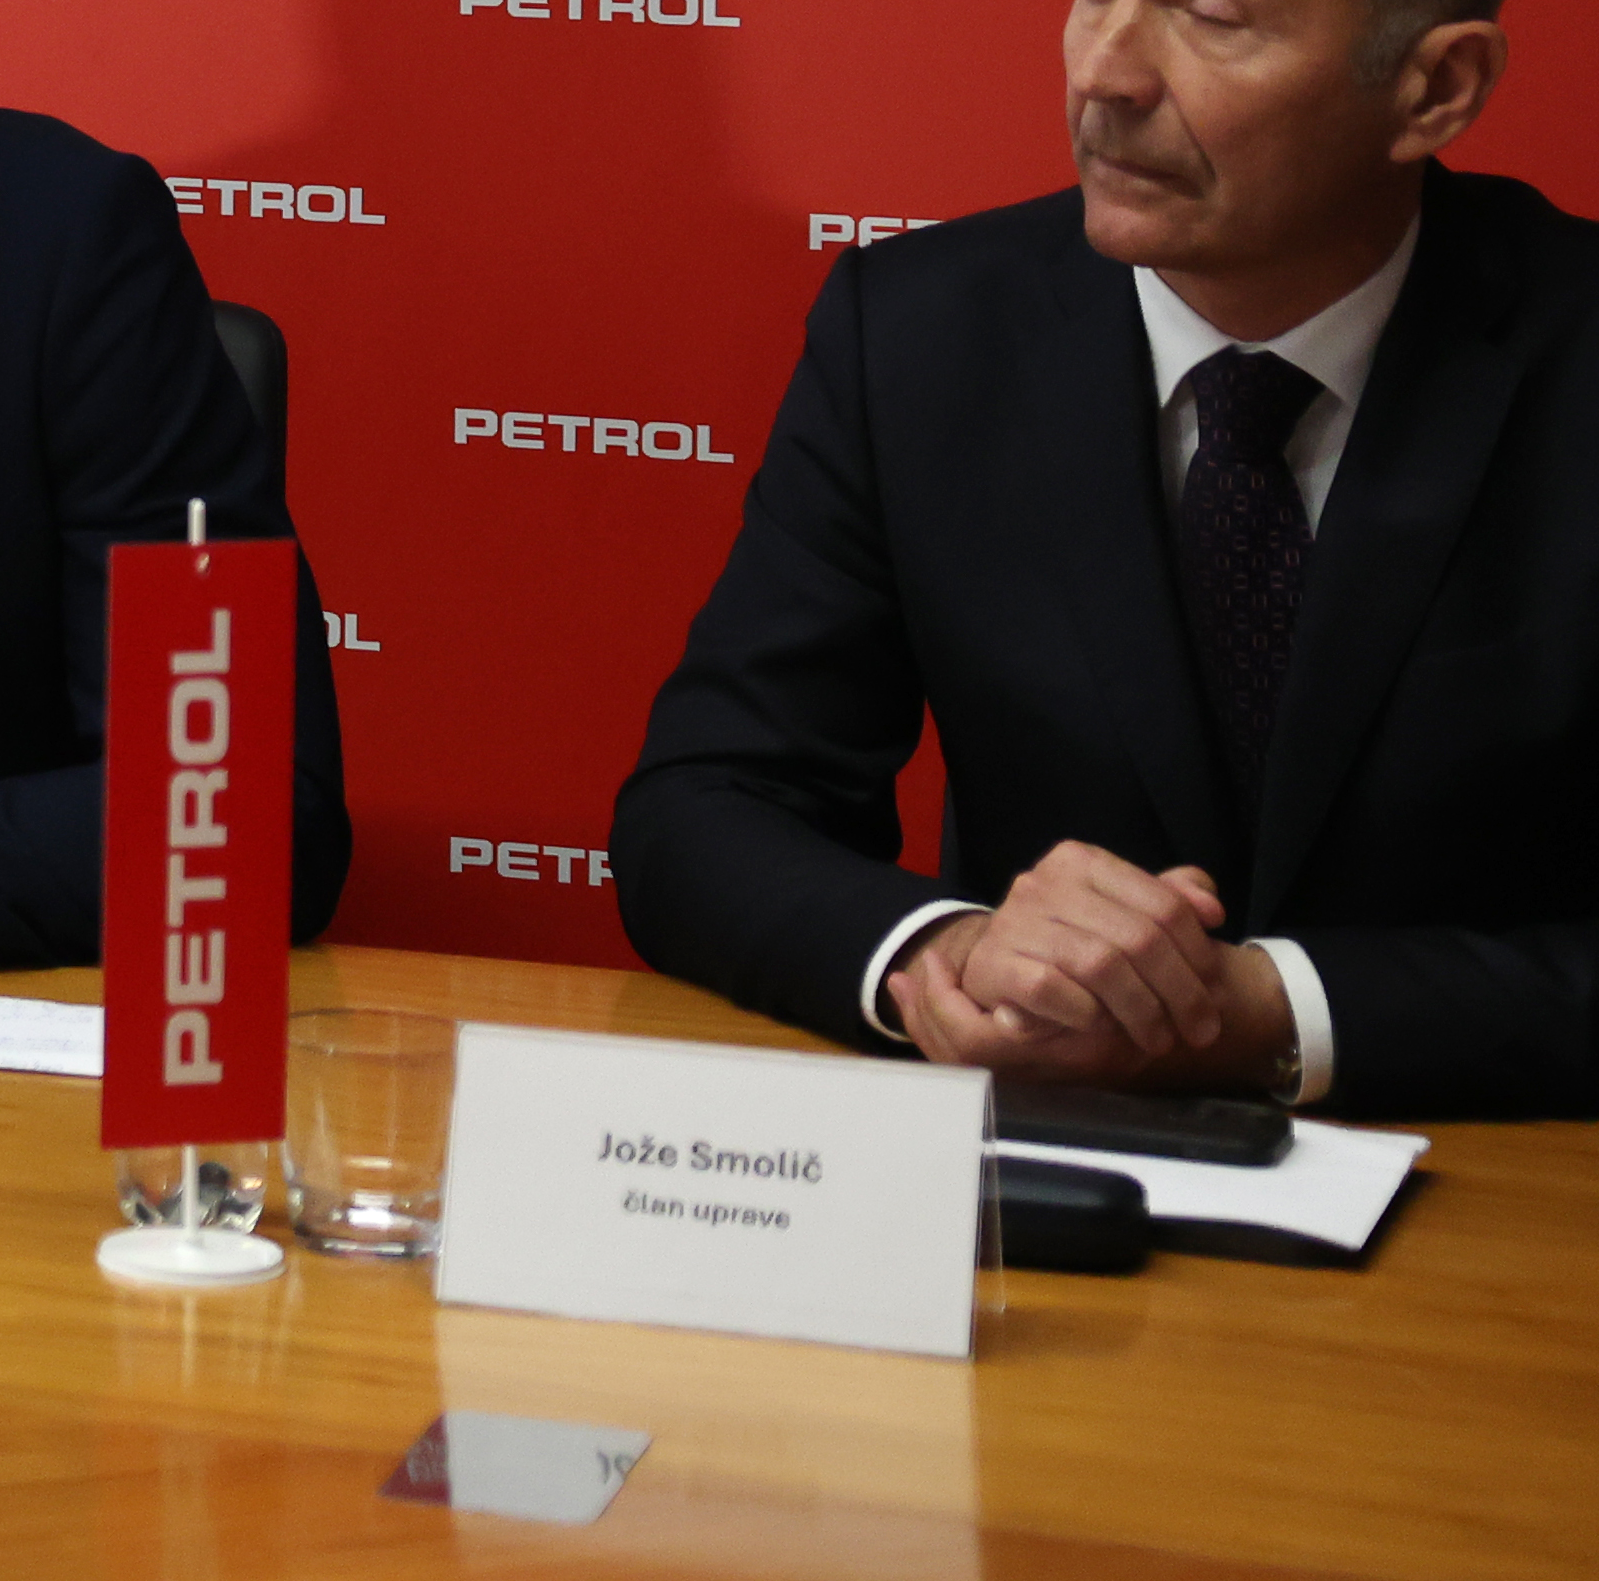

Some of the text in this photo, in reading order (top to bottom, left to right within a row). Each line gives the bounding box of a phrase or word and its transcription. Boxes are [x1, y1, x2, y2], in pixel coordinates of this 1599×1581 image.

[164, 178, 386, 224] ETROL
[455, 408, 733, 463] PETROL
[164, 609, 230, 1085] PETROL
[598, 1131, 824, 1185] Jože Smolič
[622, 1189, 791, 1230] član uprave
